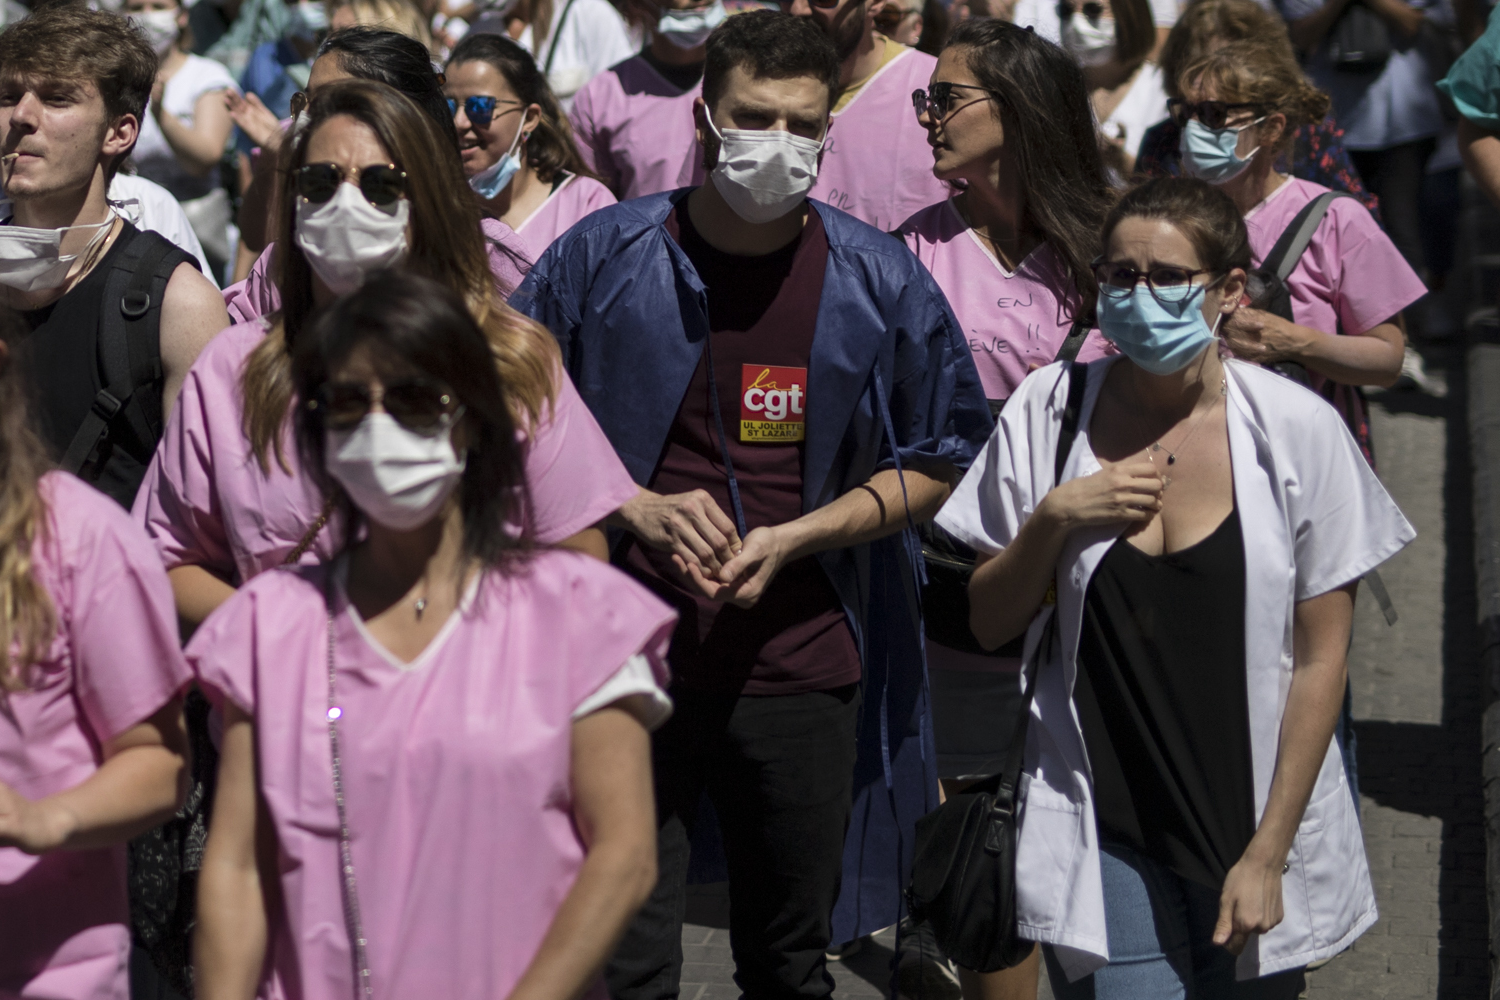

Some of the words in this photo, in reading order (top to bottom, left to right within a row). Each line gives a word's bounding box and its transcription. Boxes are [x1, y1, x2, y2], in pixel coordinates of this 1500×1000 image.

[997, 293, 1033, 308] EN
[747, 368, 789, 391] la
[744, 383, 803, 421] cgt
[758, 422, 803, 431] JOLIETTE
